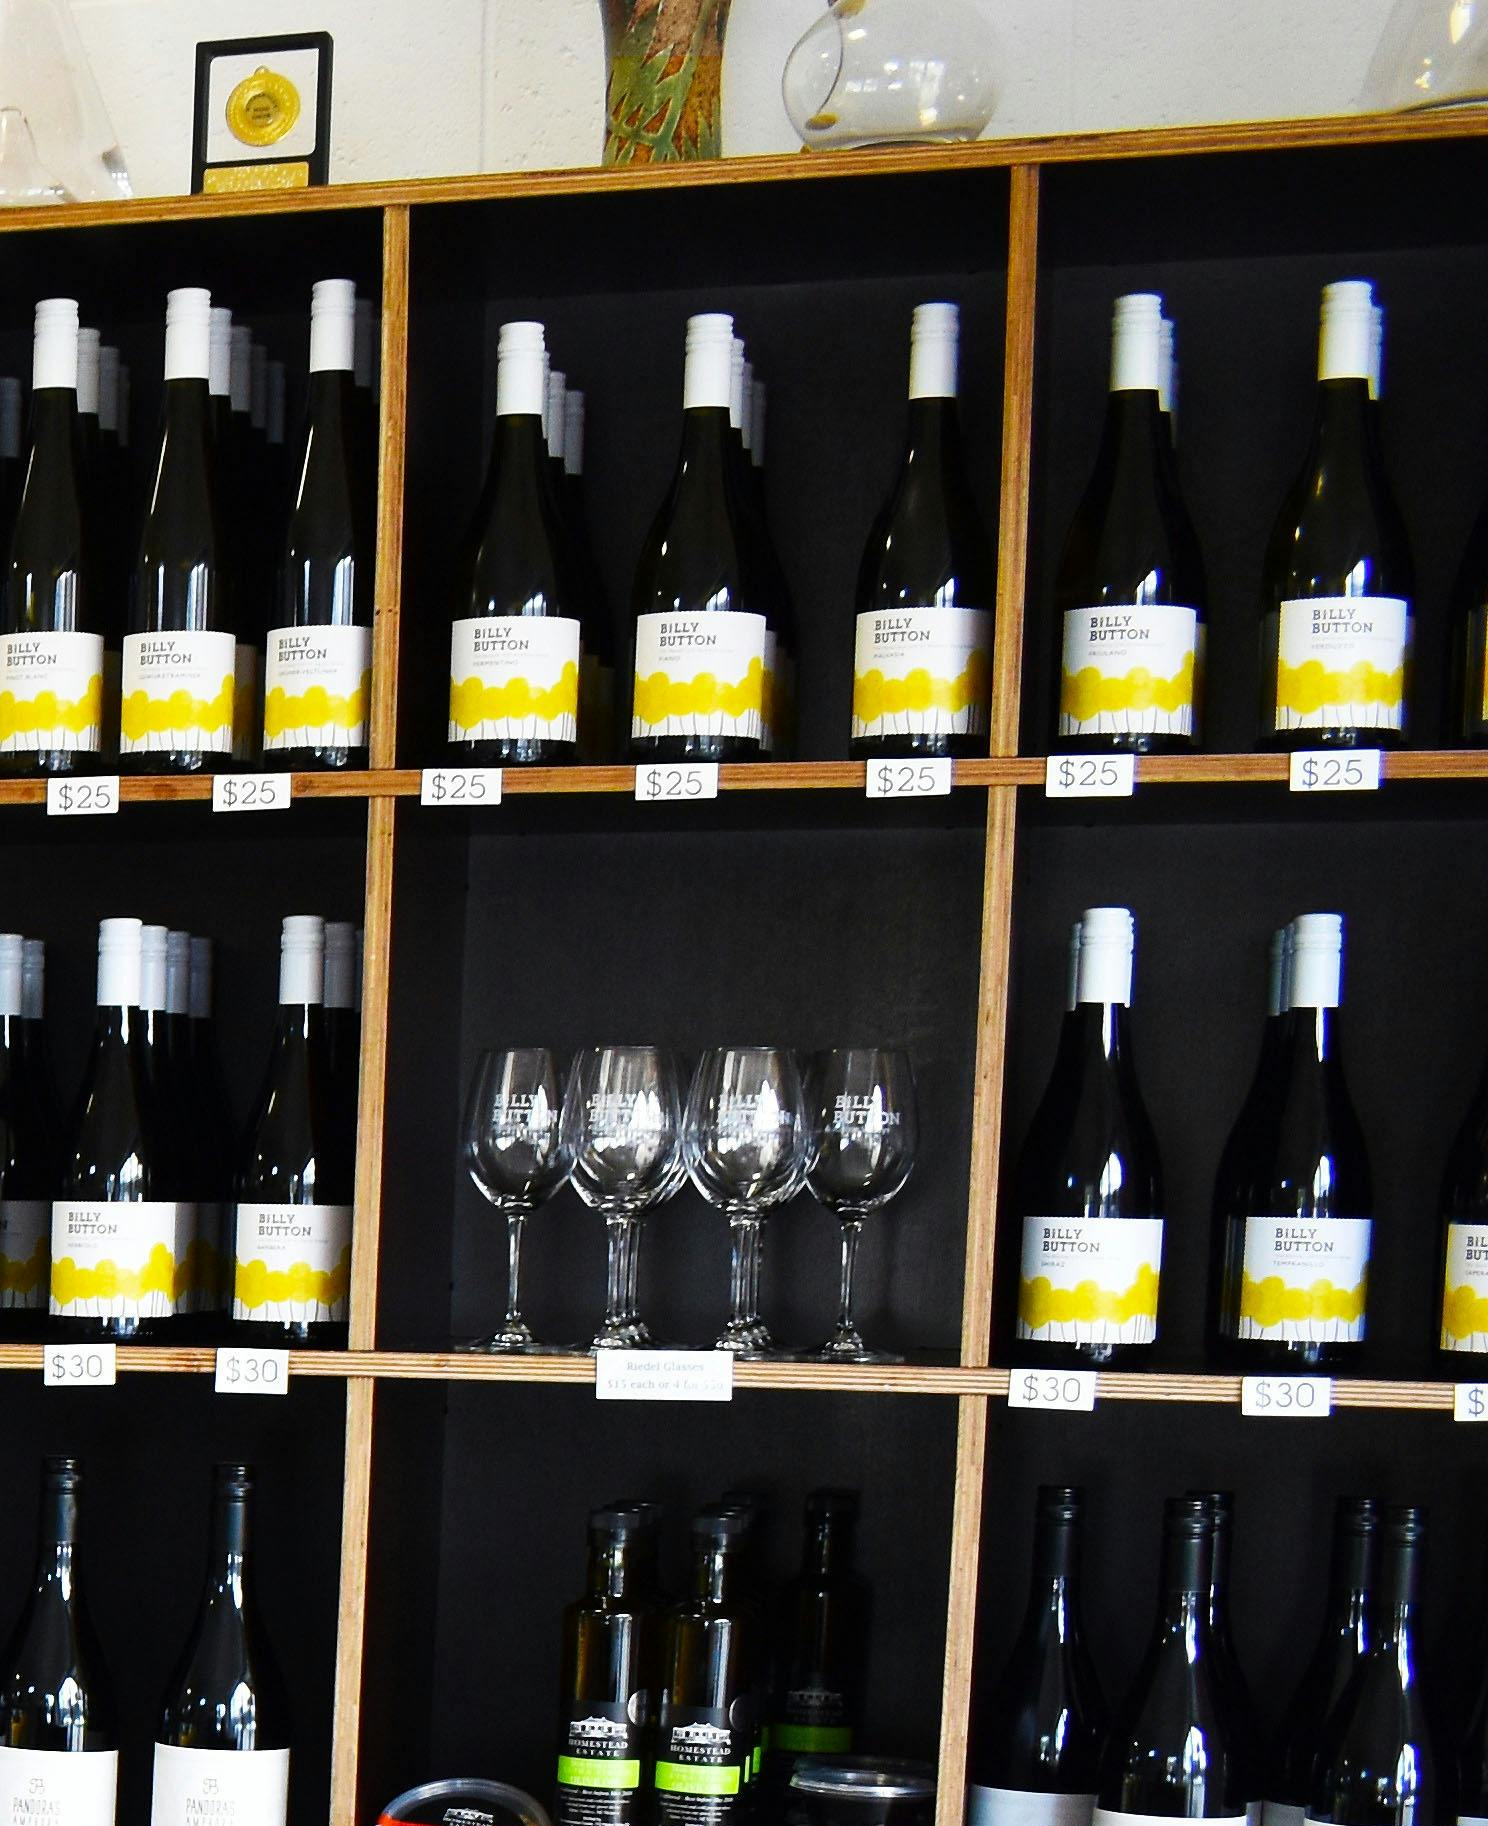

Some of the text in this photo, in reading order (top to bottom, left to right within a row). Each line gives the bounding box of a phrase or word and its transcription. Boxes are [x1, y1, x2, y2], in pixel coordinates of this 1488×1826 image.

[1311, 622, 1374, 634] BUTTON
[659, 634, 717, 647] BUTTON
[874, 630, 931, 644] BUTTON
[1089, 628, 1150, 642] BUTTON
[473, 639, 529, 652] BUTTON
[6, 654, 58, 667] BUTTON
[140, 653, 192, 666] BUTTON
[278, 648, 328, 662] BUTTON
[1059, 758, 1118, 789] $25
[1302, 757, 1363, 789] $25
[431, 772, 486, 801] $25
[646, 769, 703, 799] $25
[877, 765, 936, 796] $25
[57, 783, 112, 812] $25
[222, 779, 276, 807] $25
[67, 1223, 118, 1235] BUTTON
[258, 1226, 312, 1236] BUTTON
[1042, 1241, 1101, 1253] BUTTON
[1274, 1241, 1335, 1252] BUTTON
[51, 1354, 103, 1380] $30
[226, 1355, 278, 1383] $30
[626, 1361, 705, 1371] Riedel Glasses
[630, 1380, 656, 1389] each
[1022, 1374, 1081, 1404] $30
[1255, 1380, 1315, 1408] $30
[568, 1738, 628, 1749] HOMESTEAD
[670, 1744, 732, 1755] HOMESTEAD
[575, 1748, 621, 1757] ESTATE
[678, 1754, 723, 1763] ESTATE
